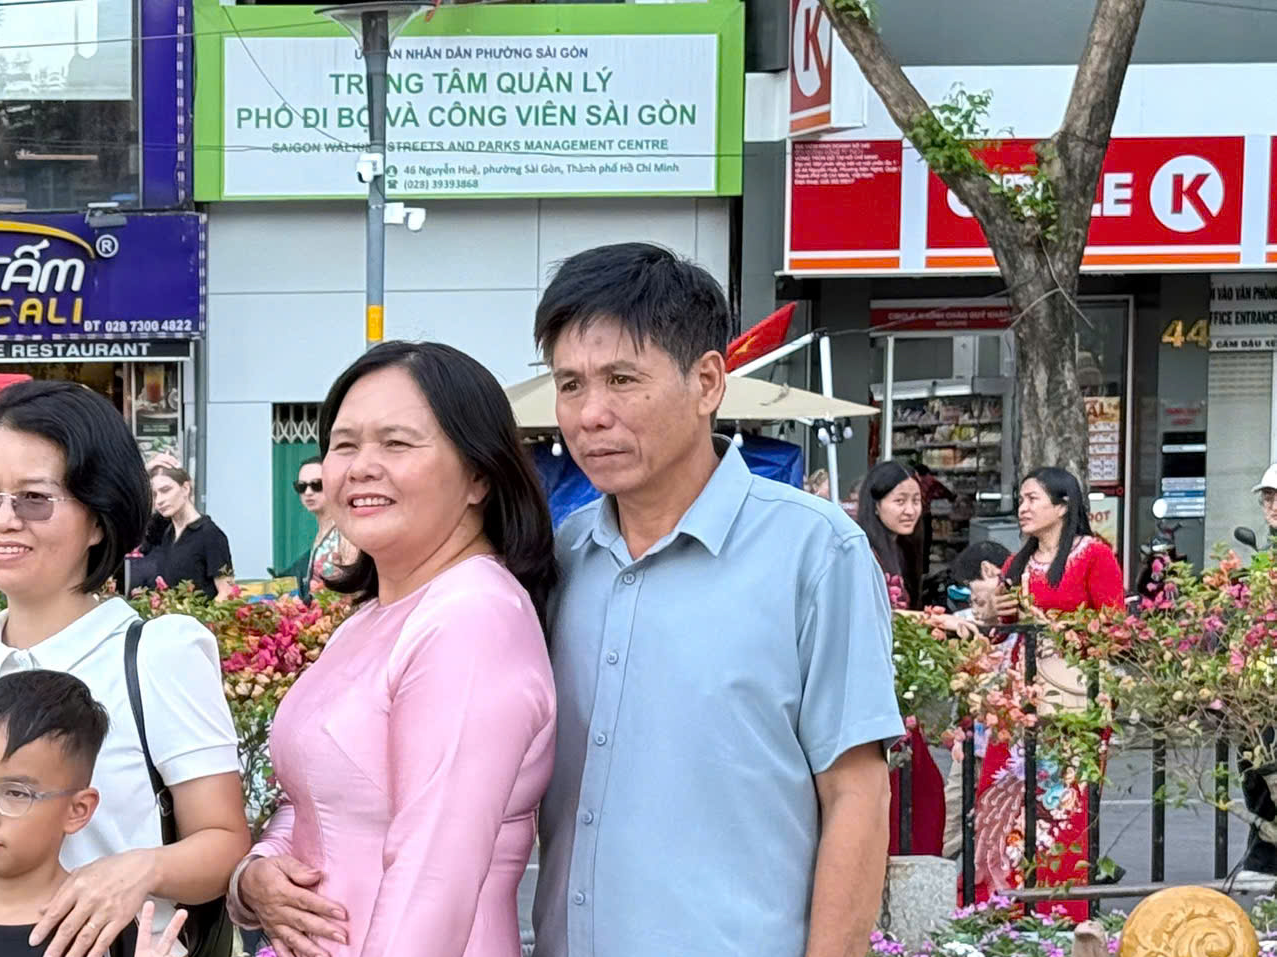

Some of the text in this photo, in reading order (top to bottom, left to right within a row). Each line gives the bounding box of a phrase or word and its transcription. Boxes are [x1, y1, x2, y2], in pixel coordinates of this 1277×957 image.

[406, 46, 442, 59] NHÂN
[446, 46, 472, 59] DÂN
[536, 46, 556, 58] SÀI
[560, 46, 588, 58] GÒN
[329, 66, 613, 95] TRNG TÂM QUẢN LÝ
[236, 102, 292, 129] PHỐ
[303, 108, 327, 128] ĐI
[386, 102, 419, 128] VÀ
[429, 102, 507, 127] CÔNG
[516, 100, 576, 126] VIÊN
[586, 99, 628, 126] SÀI
[638, 99, 696, 126] GÒN
[387, 142, 443, 152] STREETS
[448, 141, 473, 151] AND
[479, 140, 520, 151] PARKS
[524, 140, 614, 151] MANAGEMENT
[618, 139, 668, 151] CENTRE
[104, 321, 127, 332] 028
[129, 320, 159, 332] 7300
[161, 318, 192, 332] 4822
[1161, 319, 1209, 348] 44
[12, 342, 151, 358] RESTAURANT
